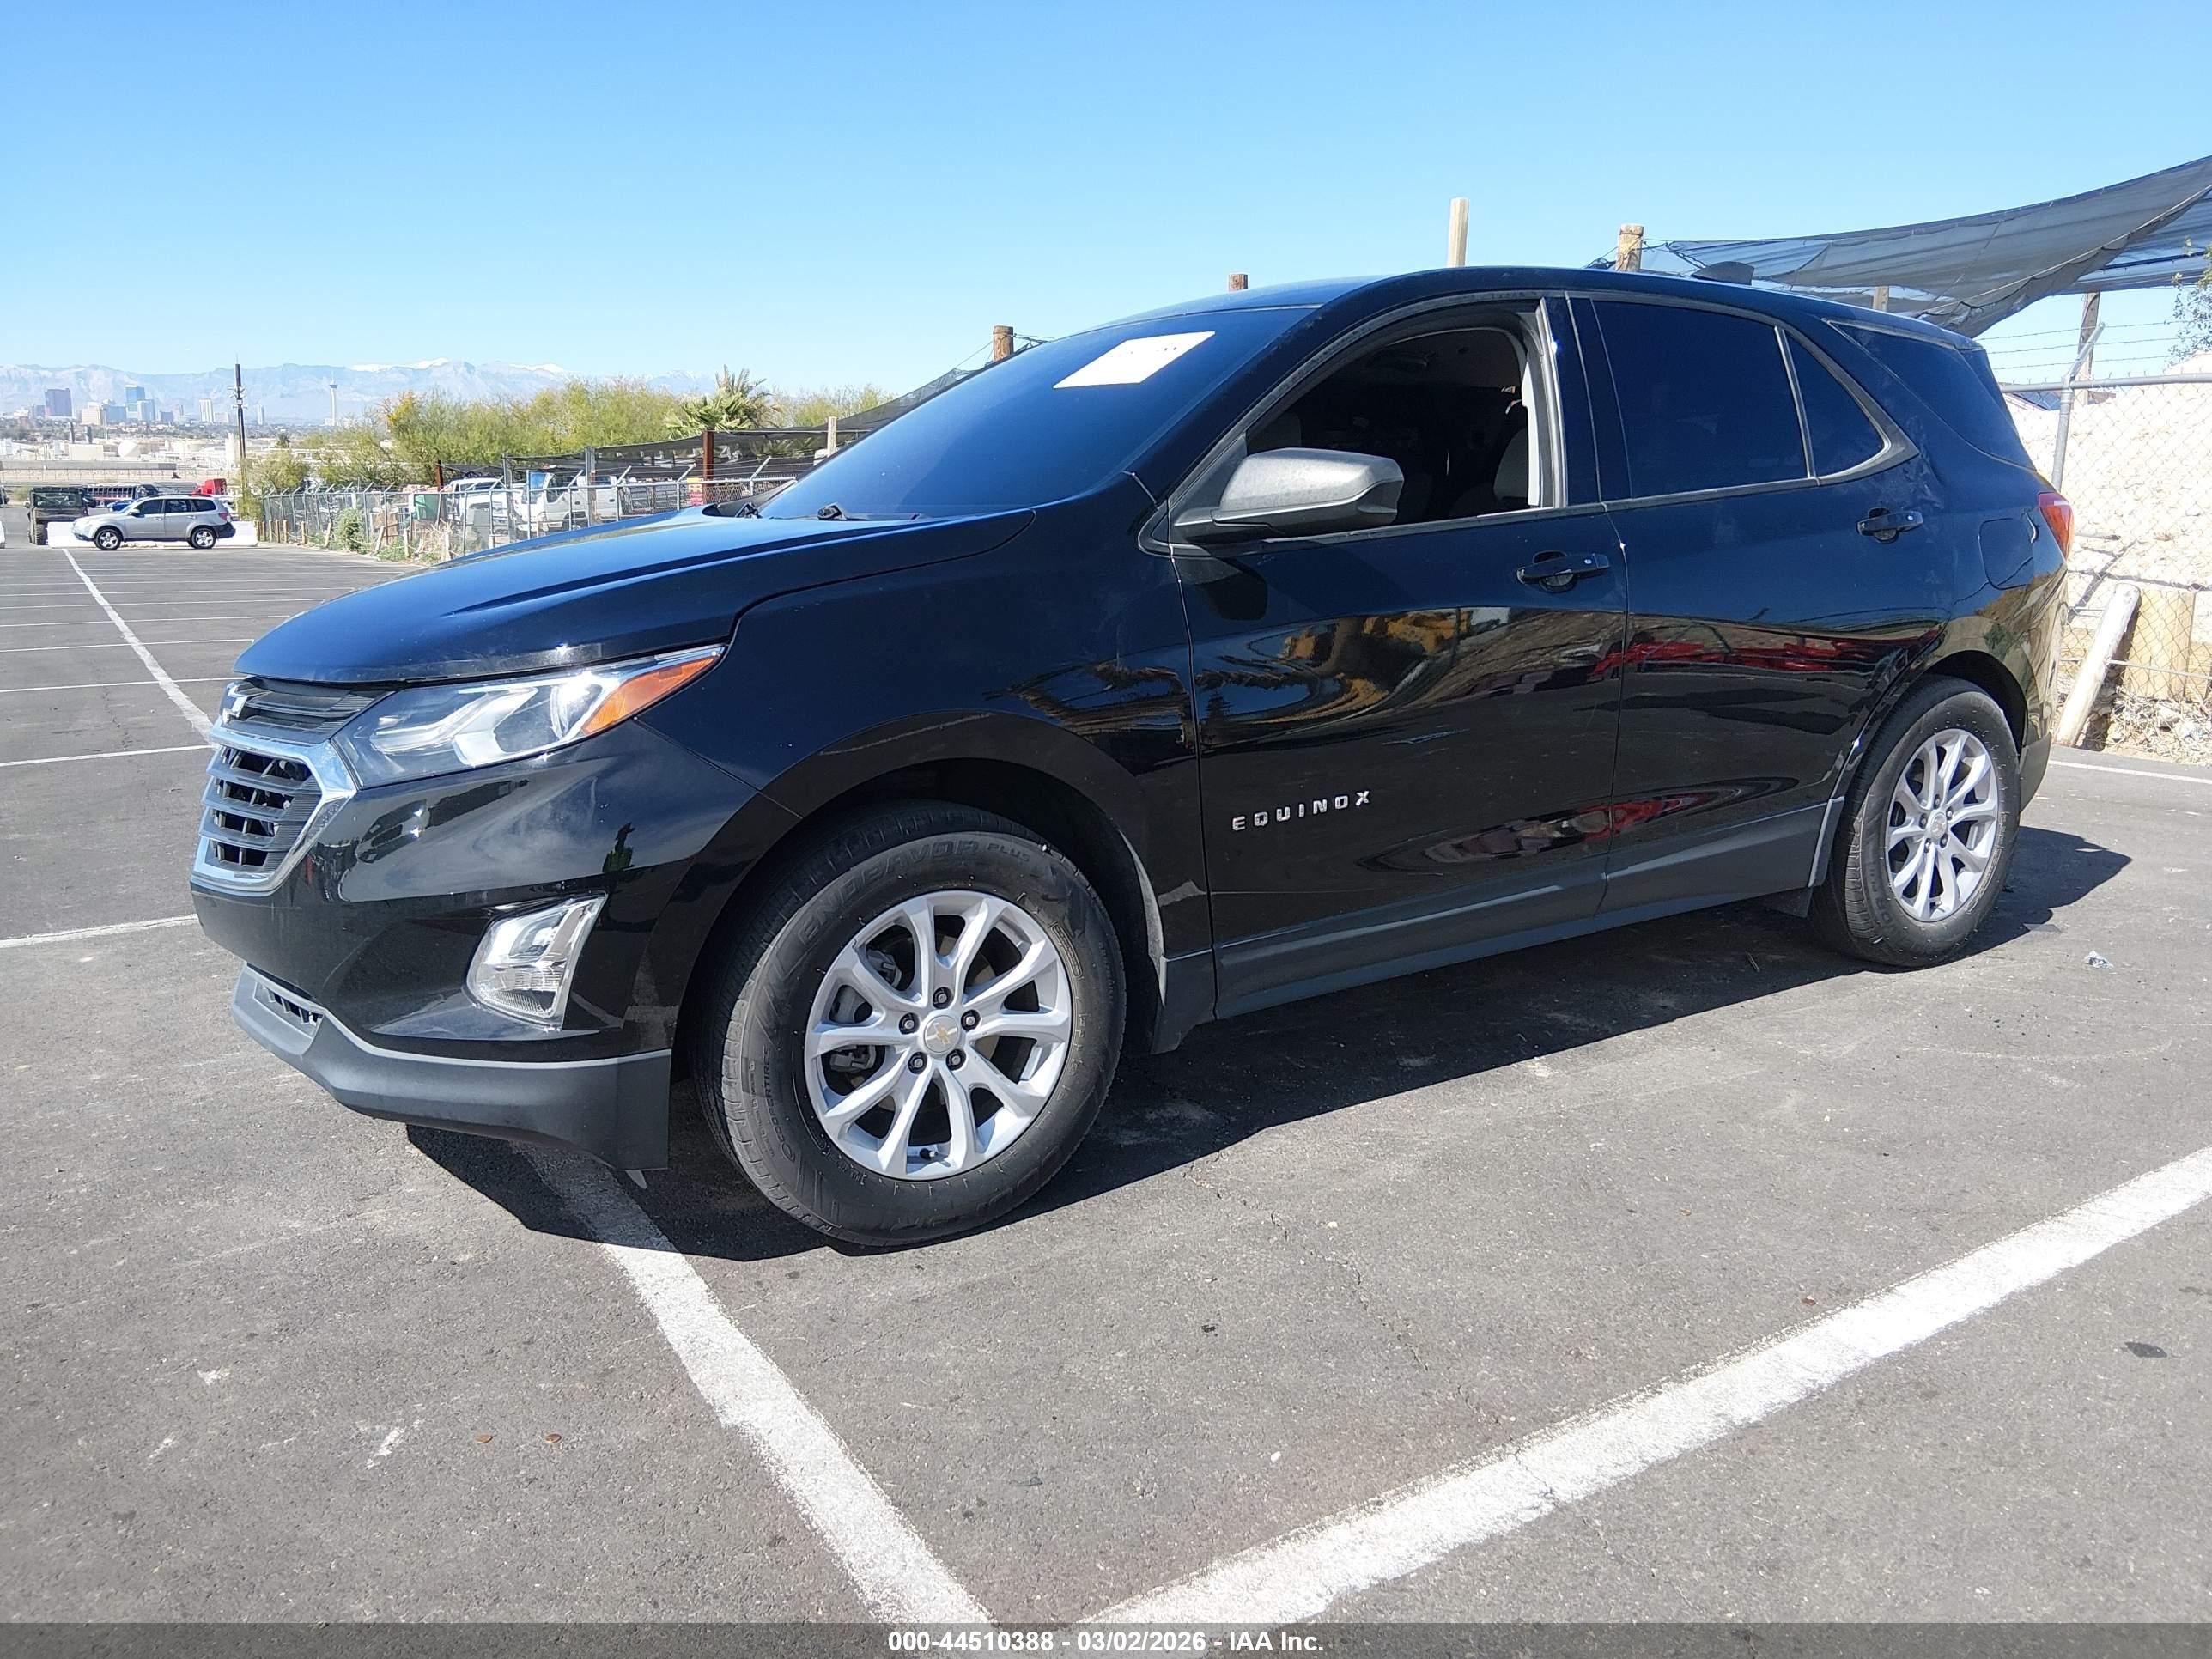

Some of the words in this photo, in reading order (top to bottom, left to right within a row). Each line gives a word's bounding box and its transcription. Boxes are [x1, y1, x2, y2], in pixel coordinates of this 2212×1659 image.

[1232, 790, 1370, 831] EQUINOX
[798, 838, 979, 944] ENDEAVOR
[986, 842, 1032, 863] PLUS
